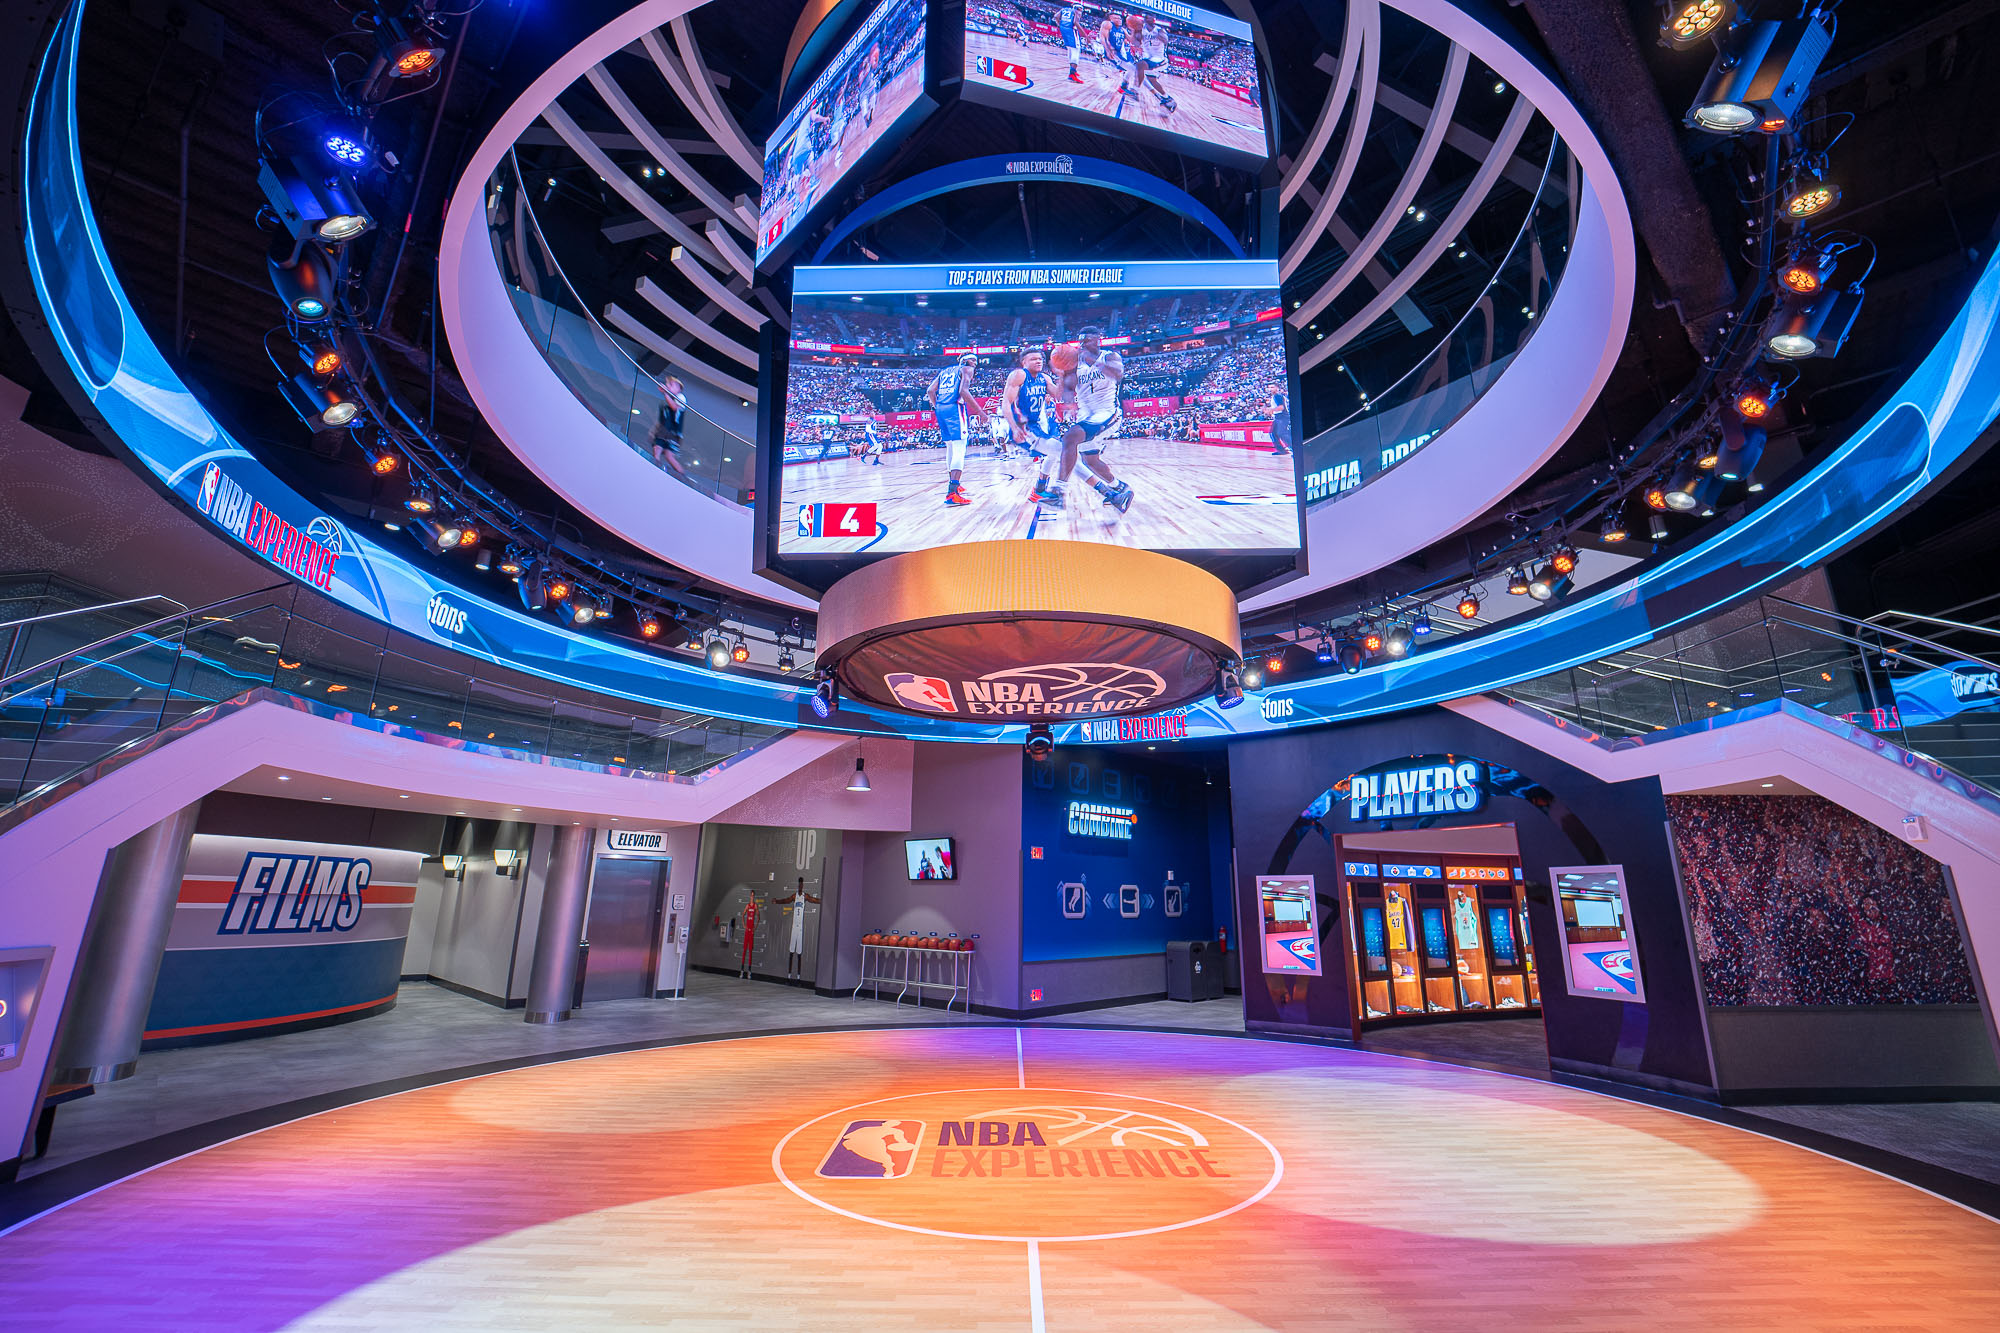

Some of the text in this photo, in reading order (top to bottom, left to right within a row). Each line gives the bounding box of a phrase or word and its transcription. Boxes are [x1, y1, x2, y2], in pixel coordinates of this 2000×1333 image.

[1164, 1, 1192, 20] LEAGUE
[1003, 65, 1017, 80] 4
[1013, 161, 1073, 175] NBA EXPERIENCE
[772, 224, 779, 240] 9
[949, 268, 1124, 285] TOP 5 PLAYS FROM NBA SUMMER LEAGUE
[939, 372, 956, 388] 23
[840, 507, 860, 533] 4
[211, 473, 340, 592] NBA EXPERIENCE
[962, 680, 1045, 702] NBA
[967, 696, 1155, 715] EXPERIENCE
[1093, 714, 1188, 742] NBA EXPERIENCE
[1349, 761, 1482, 821] PLAYERS
[1068, 801, 1134, 840] COMBINE
[617, 832, 662, 848] ELEVATOR
[796, 829, 817, 870] UP
[219, 853, 372, 933] FILMS
[937, 1121, 1047, 1146] NBA
[931, 1149, 1231, 1178] EXPERIENCE
